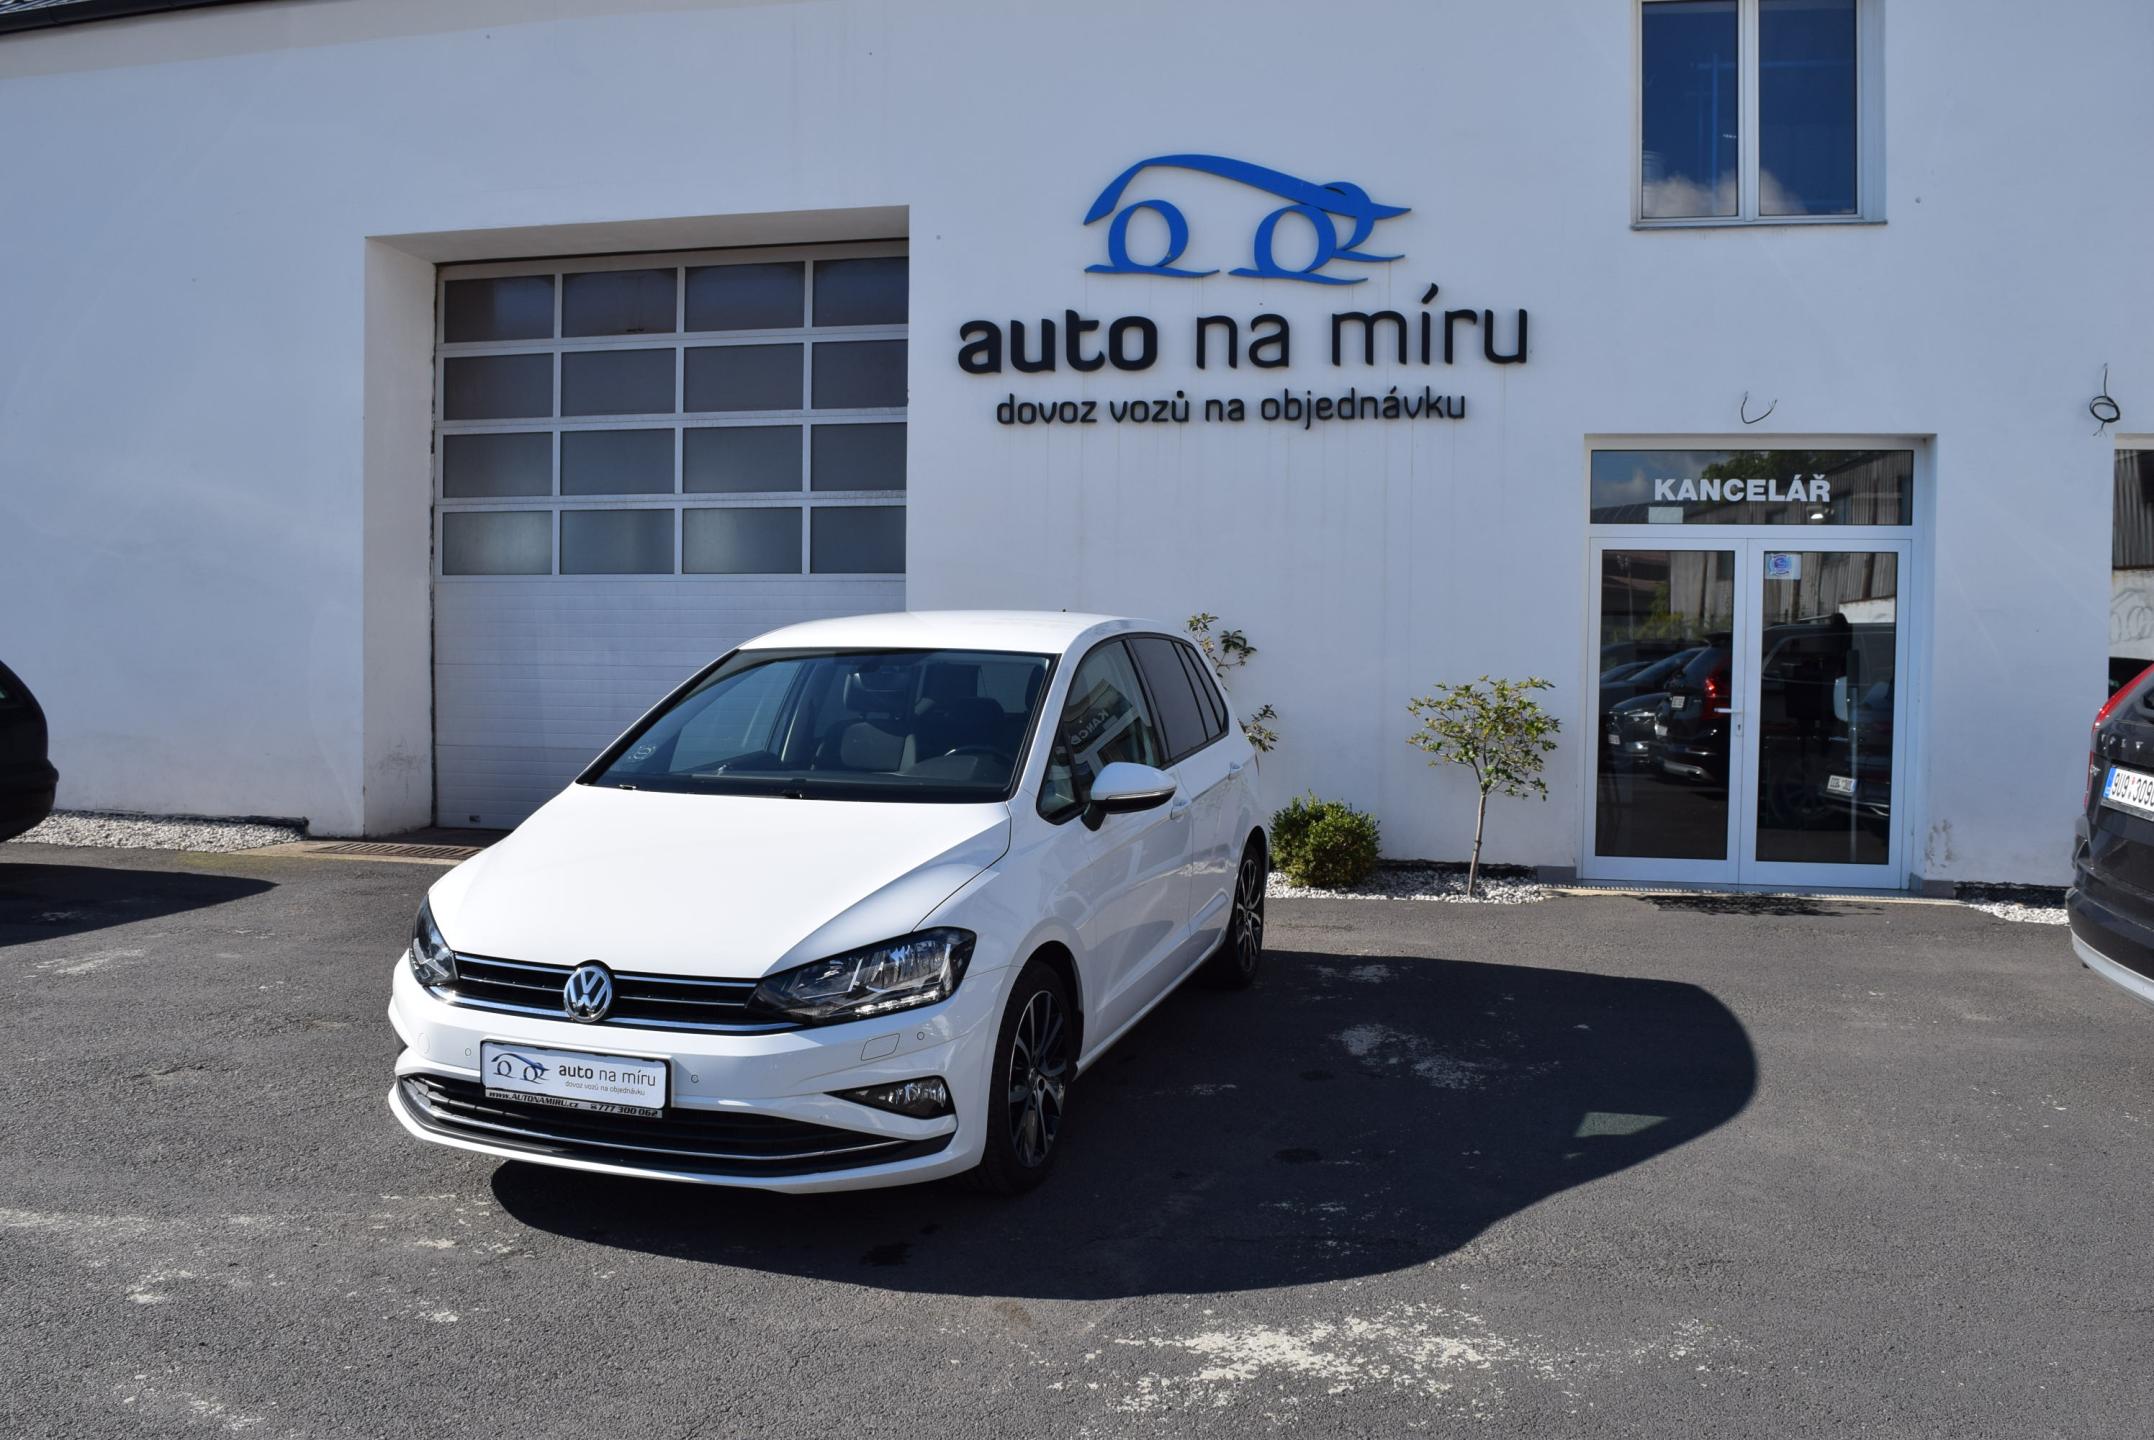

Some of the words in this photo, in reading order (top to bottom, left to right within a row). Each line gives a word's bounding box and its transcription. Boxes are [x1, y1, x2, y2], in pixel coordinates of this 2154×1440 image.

[958, 309, 1157, 375] auto
[1196, 313, 1290, 370] na
[1332, 282, 1528, 367] míru
[997, 392, 1098, 425] dovoz
[1109, 390, 1190, 424] vozů
[1204, 398, 1245, 422] na
[1261, 385, 1466, 430] objednávku
[1654, 474, 1831, 502] KANCELÁŘ
[559, 1065, 594, 1079] auto
[599, 1069, 617, 1082] na
[622, 1069, 656, 1086] míru
[565, 1080, 583, 1089] dovoz
[584, 1083, 599, 1091] vozů
[610, 1086, 646, 1096] objednávku
[617, 1106, 637, 1115] 300
